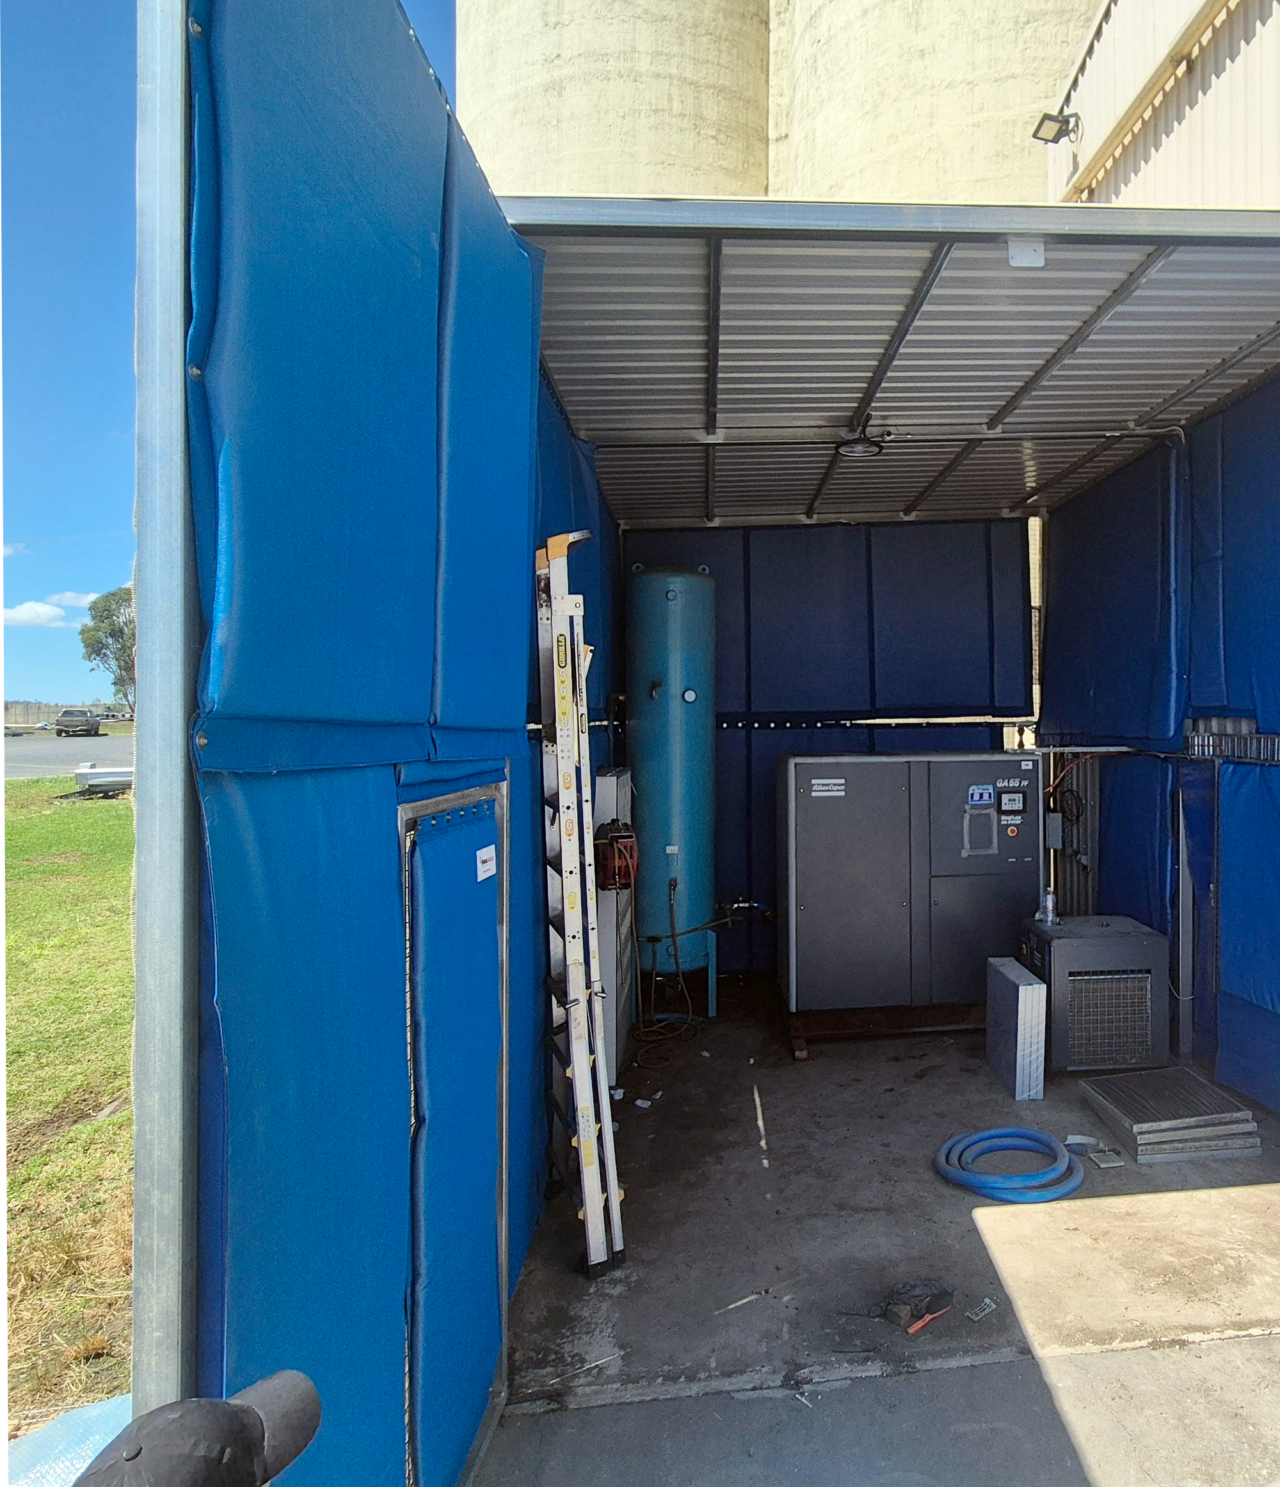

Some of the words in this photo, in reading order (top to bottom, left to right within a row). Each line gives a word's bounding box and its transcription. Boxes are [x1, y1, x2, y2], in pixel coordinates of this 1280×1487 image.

[560, 669, 566, 680] 5
[560, 685, 567, 695] 6
[561, 701, 567, 711] 7
[561, 716, 568, 727] 8
[564, 773, 571, 783] 5
[566, 820, 573, 830] 6
